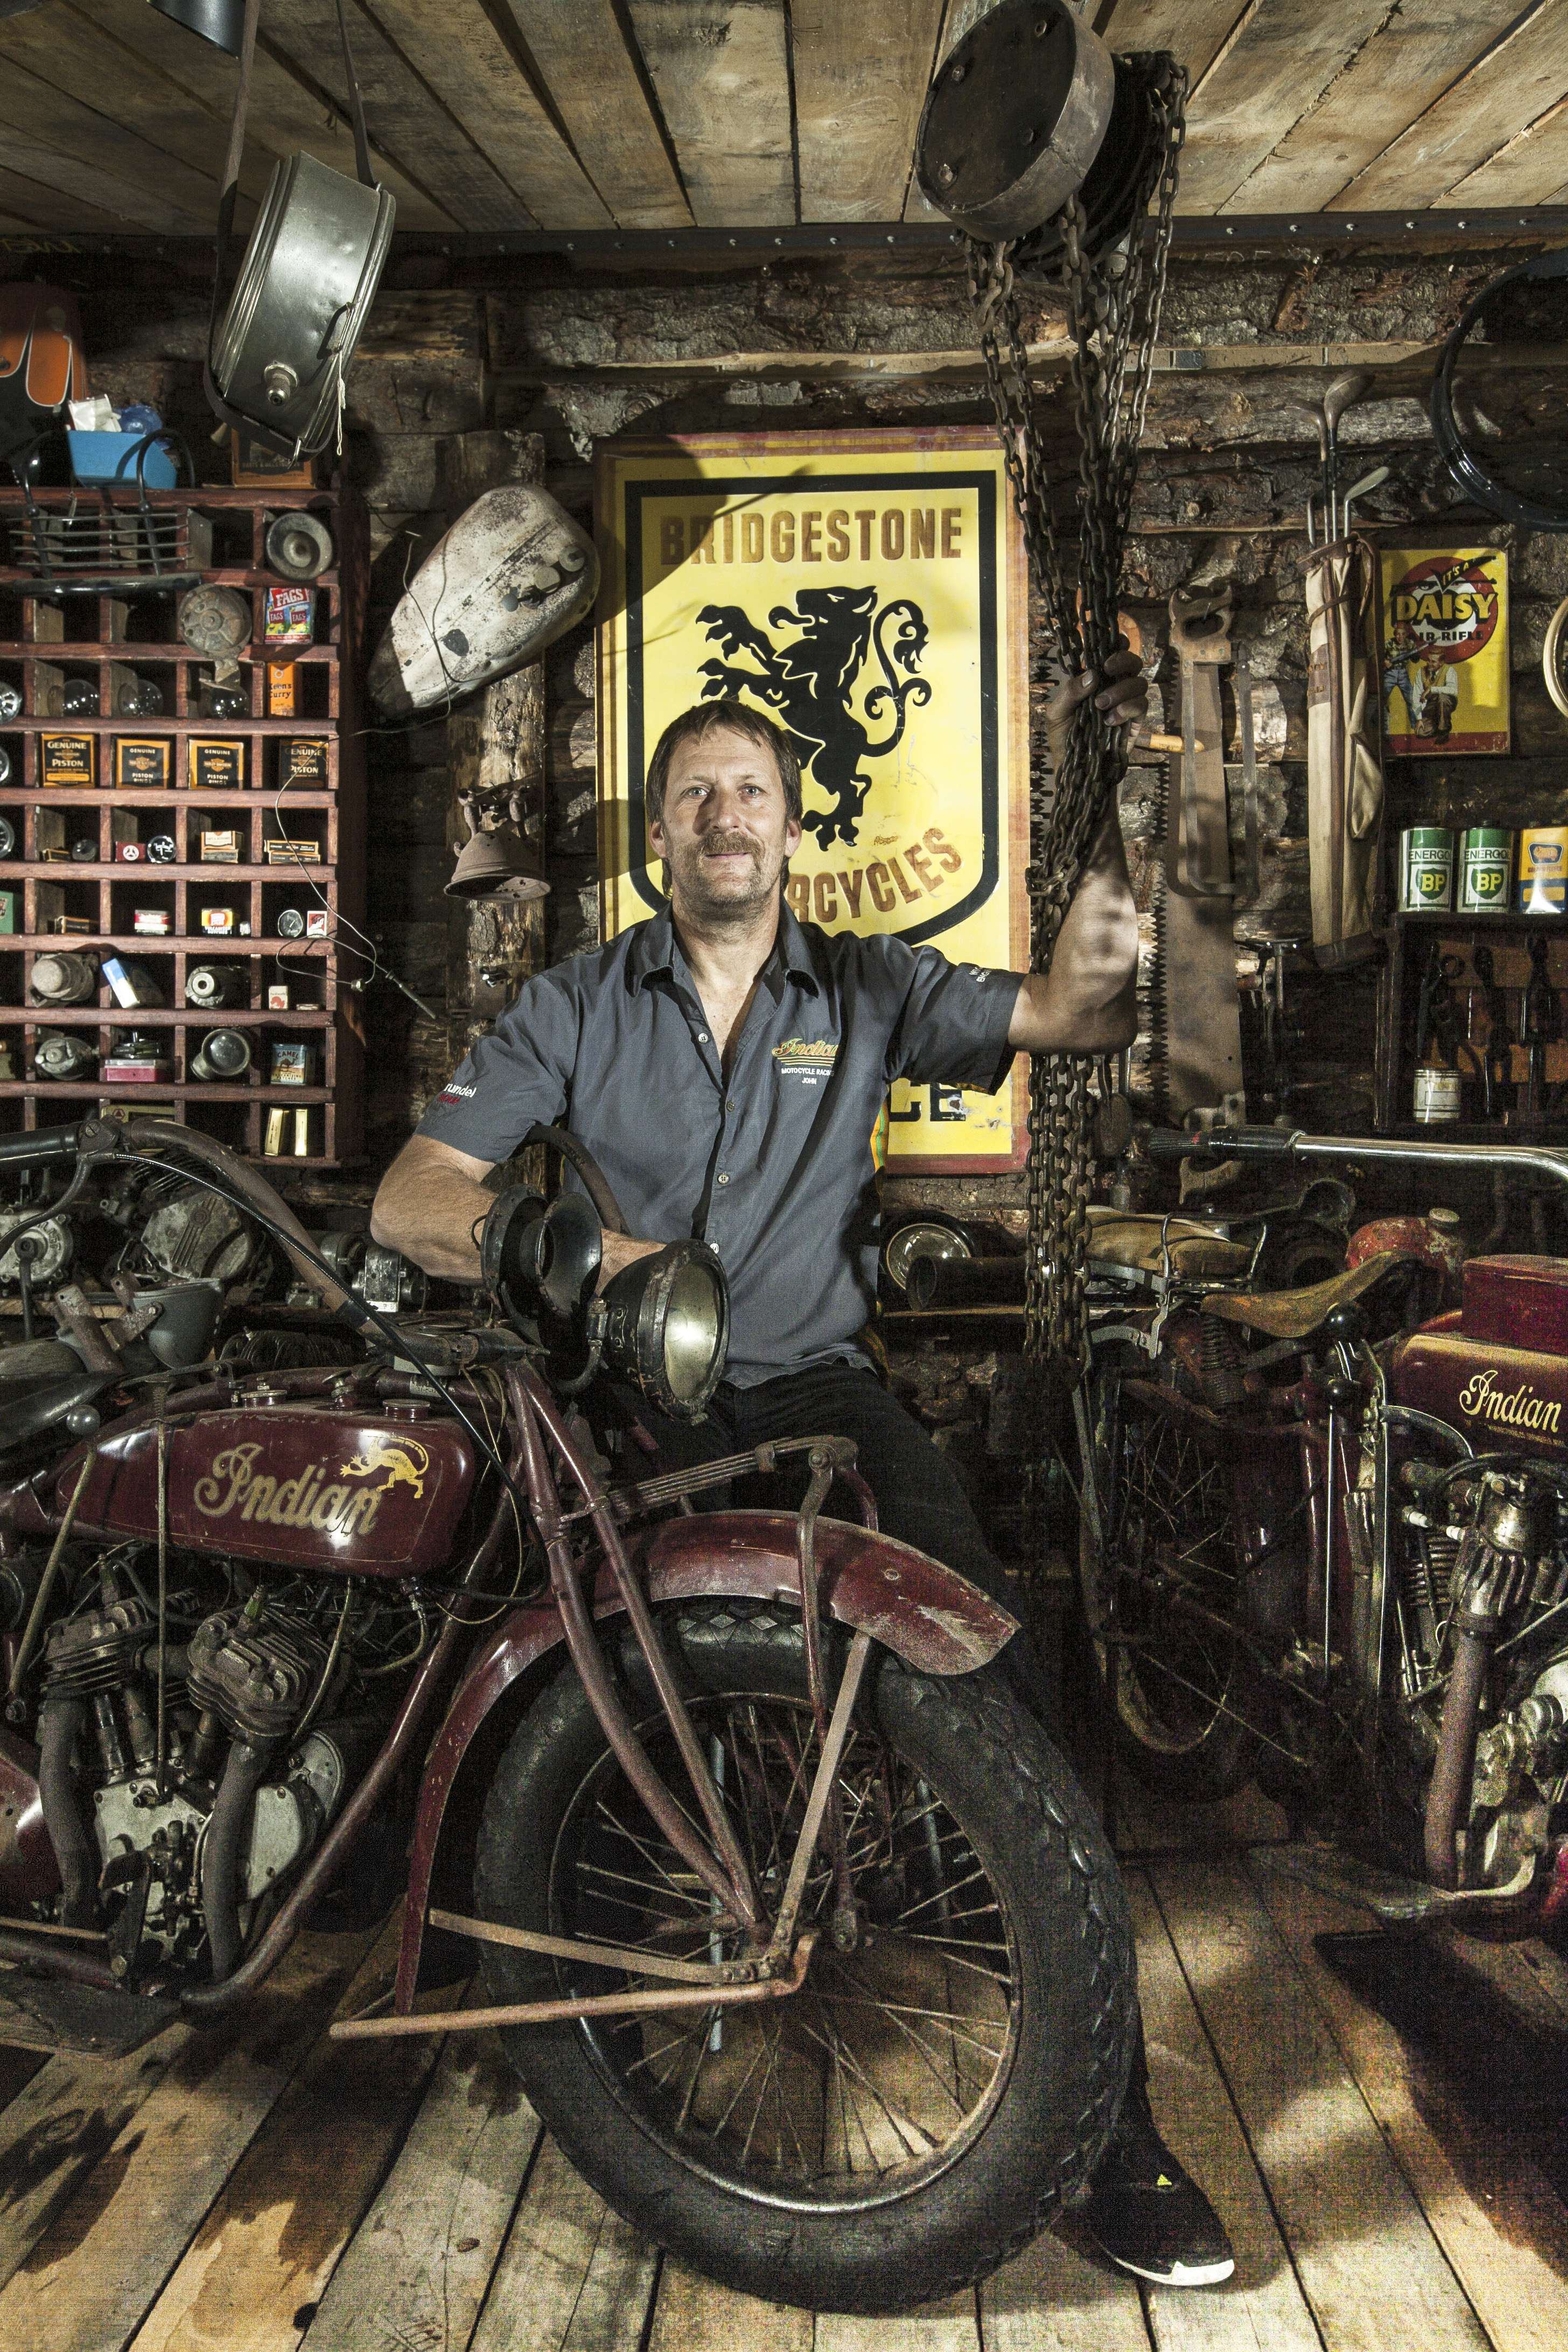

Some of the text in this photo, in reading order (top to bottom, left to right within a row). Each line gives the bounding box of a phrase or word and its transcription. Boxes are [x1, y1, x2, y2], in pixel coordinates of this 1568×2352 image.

[660, 508, 962, 565] BRIDGESTONE
[1463, 562, 1469, 571] A
[275, 588, 304, 607] FAGS
[1396, 593, 1496, 621] DAISY
[270, 613, 284, 621] FAGS
[1441, 631, 1484, 641] RIFLE
[47, 741, 87, 749] GENUINE
[52, 759, 84, 767] PISTON
[787, 828, 964, 922] RCYCLES
[1421, 873, 1445, 892] BP
[1475, 873, 1501, 891] BP
[277, 1051, 299, 1059] CAMEL
[816, 1068, 835, 1076] RACING
[443, 1083, 477, 1098] rundel
[1459, 1369, 1562, 1433] Indian
[193, 1443, 383, 1535] Indian
